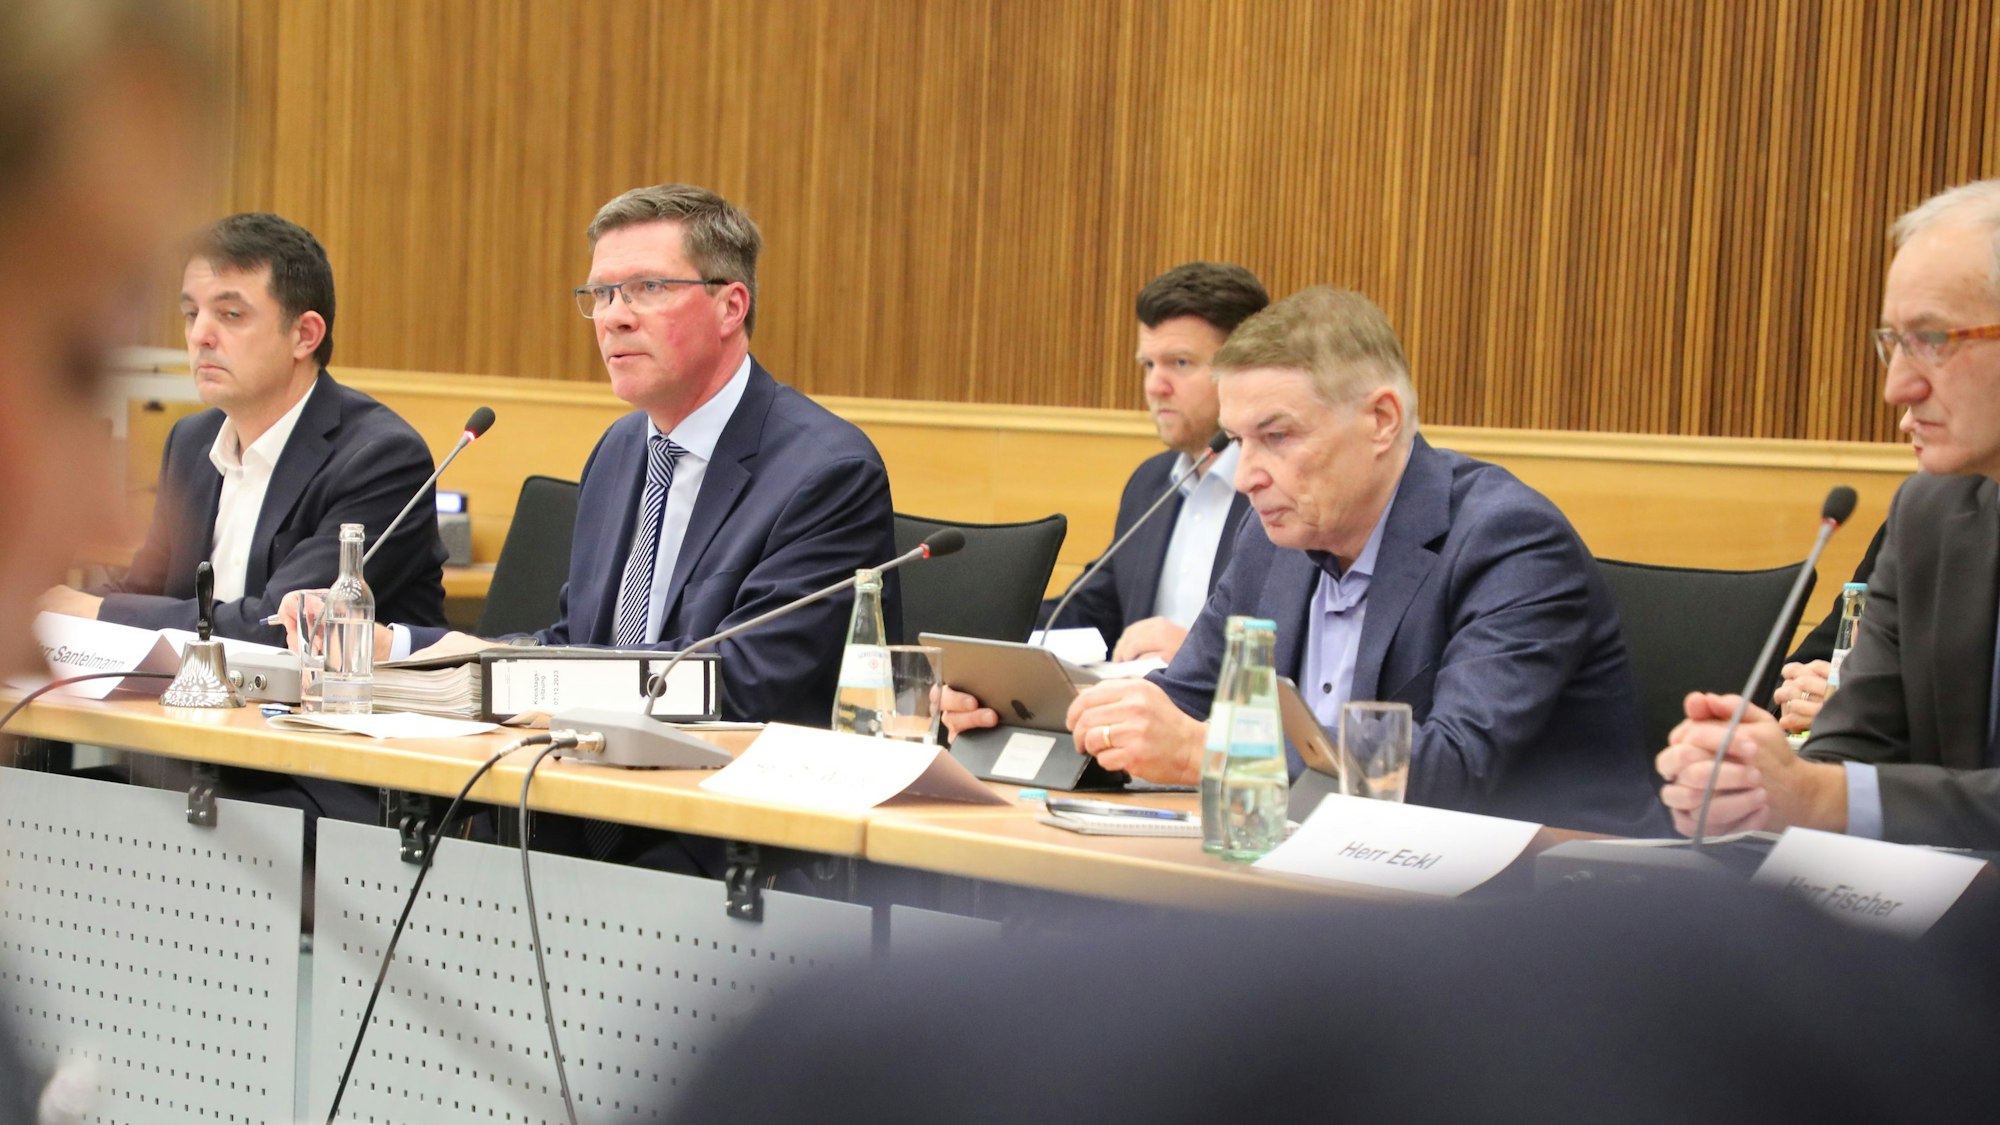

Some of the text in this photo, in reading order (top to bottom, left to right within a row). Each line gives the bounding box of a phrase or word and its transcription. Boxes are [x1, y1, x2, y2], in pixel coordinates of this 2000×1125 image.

[53, 645, 125, 671] Santelmann
[1338, 841, 1442, 870] Herr Eckl
[1824, 884, 1904, 917] Fischer
